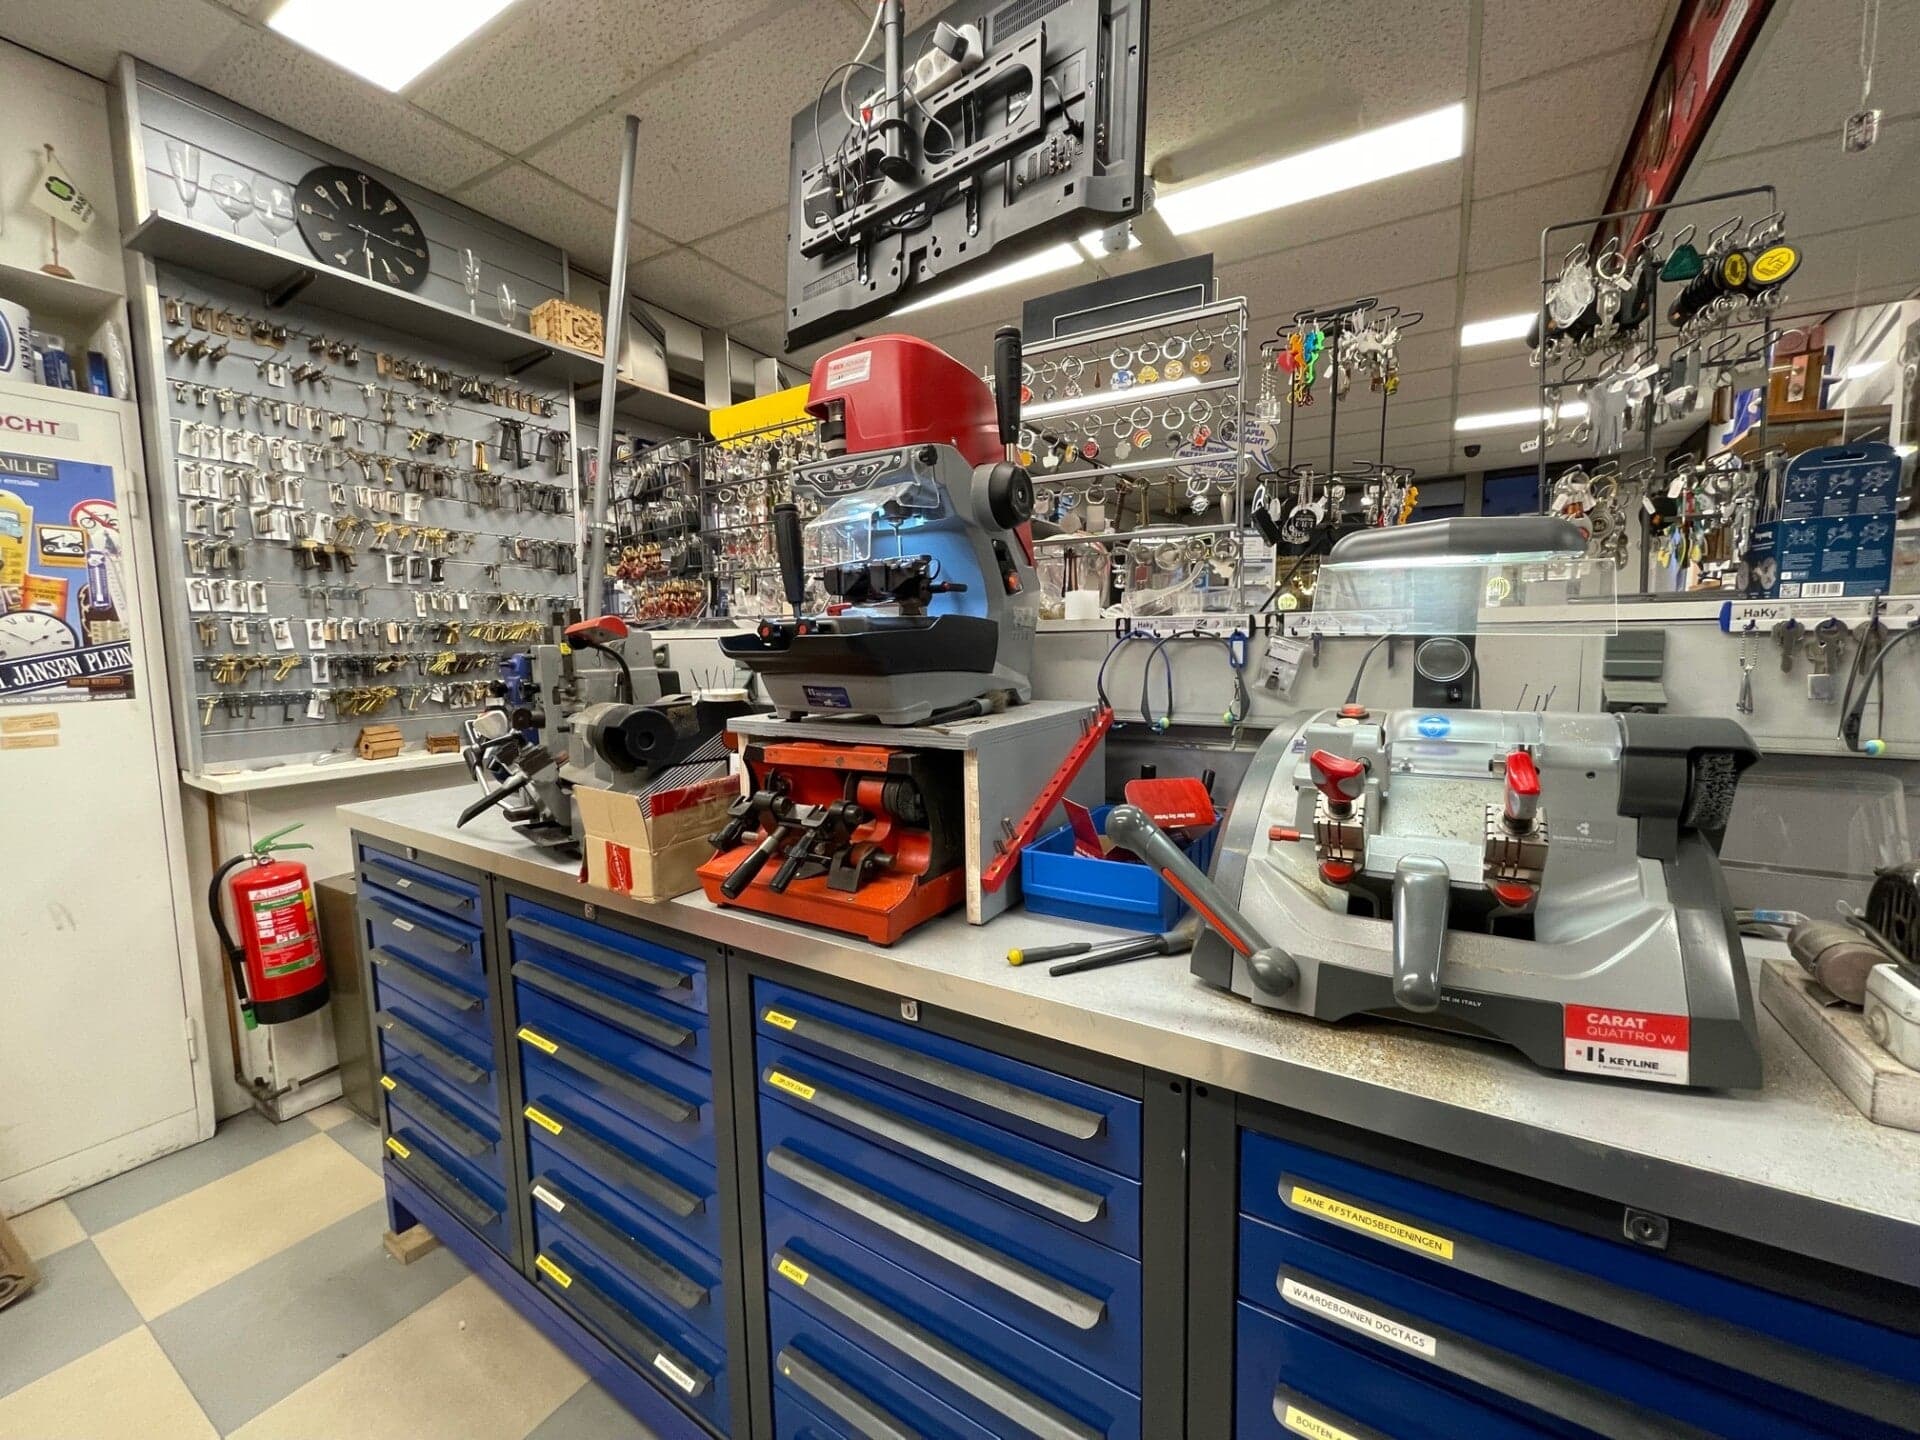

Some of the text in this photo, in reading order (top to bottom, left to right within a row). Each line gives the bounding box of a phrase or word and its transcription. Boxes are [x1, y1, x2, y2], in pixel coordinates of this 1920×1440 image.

[0, 415, 60, 435] CHT
[1743, 608, 1777, 618] HaKy
[12, 655, 82, 687] JANSEN
[84, 646, 133, 673] PLEIN
[1587, 1013, 1648, 1029] CARAT
[1587, 1026, 1676, 1045] QUATTRO W
[1609, 1056, 1660, 1070] KEYLINE
[1303, 1194, 1442, 1251] JANE AFSTANDSBEDIENINGEN
[1293, 1287, 1425, 1348] WAARDEBONNEN DOGTAGS
[1295, 1415, 1333, 1439] BOUTEN
